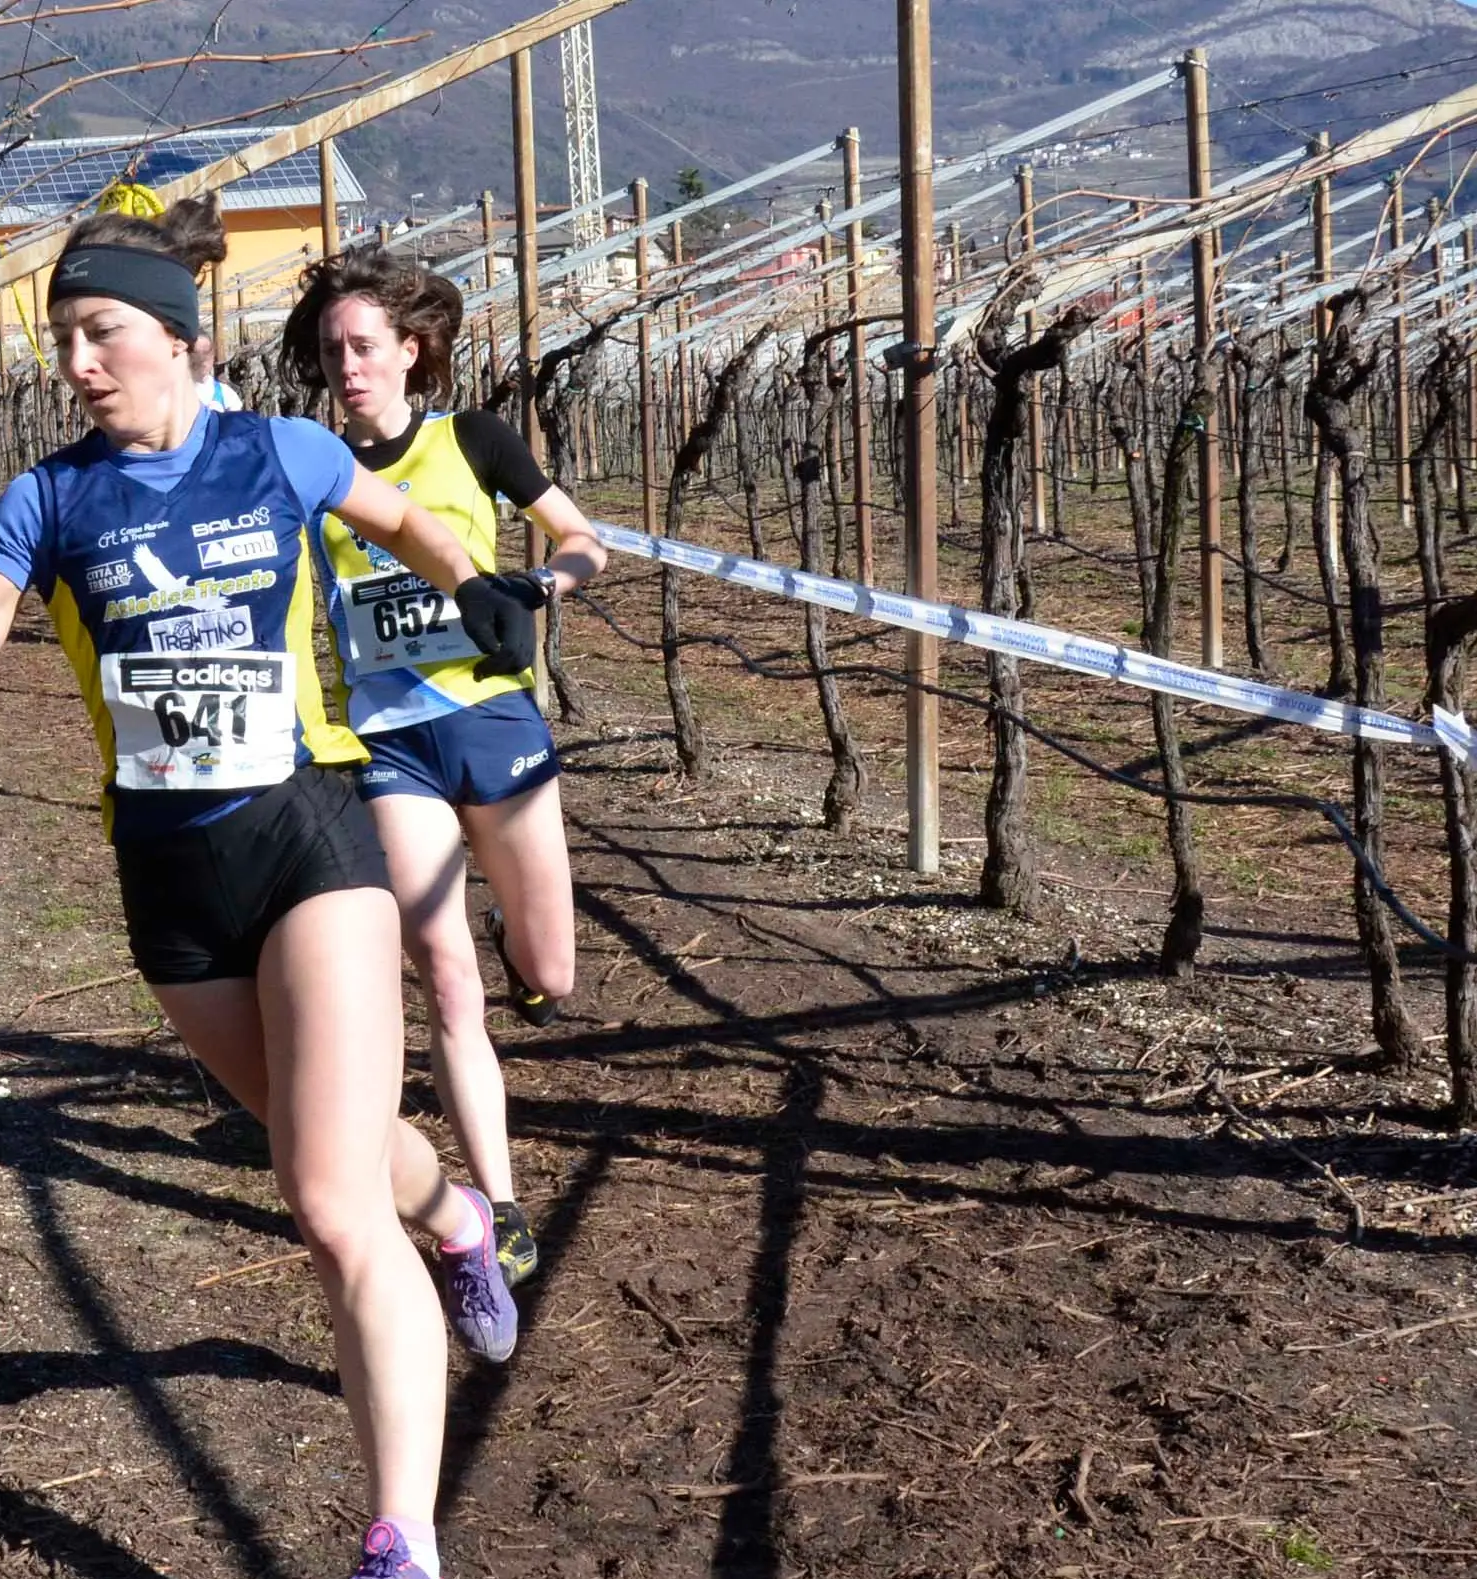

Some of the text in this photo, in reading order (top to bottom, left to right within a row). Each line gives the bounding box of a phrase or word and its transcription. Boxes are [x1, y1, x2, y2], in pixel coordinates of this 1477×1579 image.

[231, 533, 276, 557] cmb
[388, 576, 430, 594] adid
[373, 592, 449, 643] 652
[153, 620, 247, 652] TRENTINO
[176, 663, 274, 688] adidas
[154, 691, 247, 749] 641
[526, 748, 549, 769] asics
